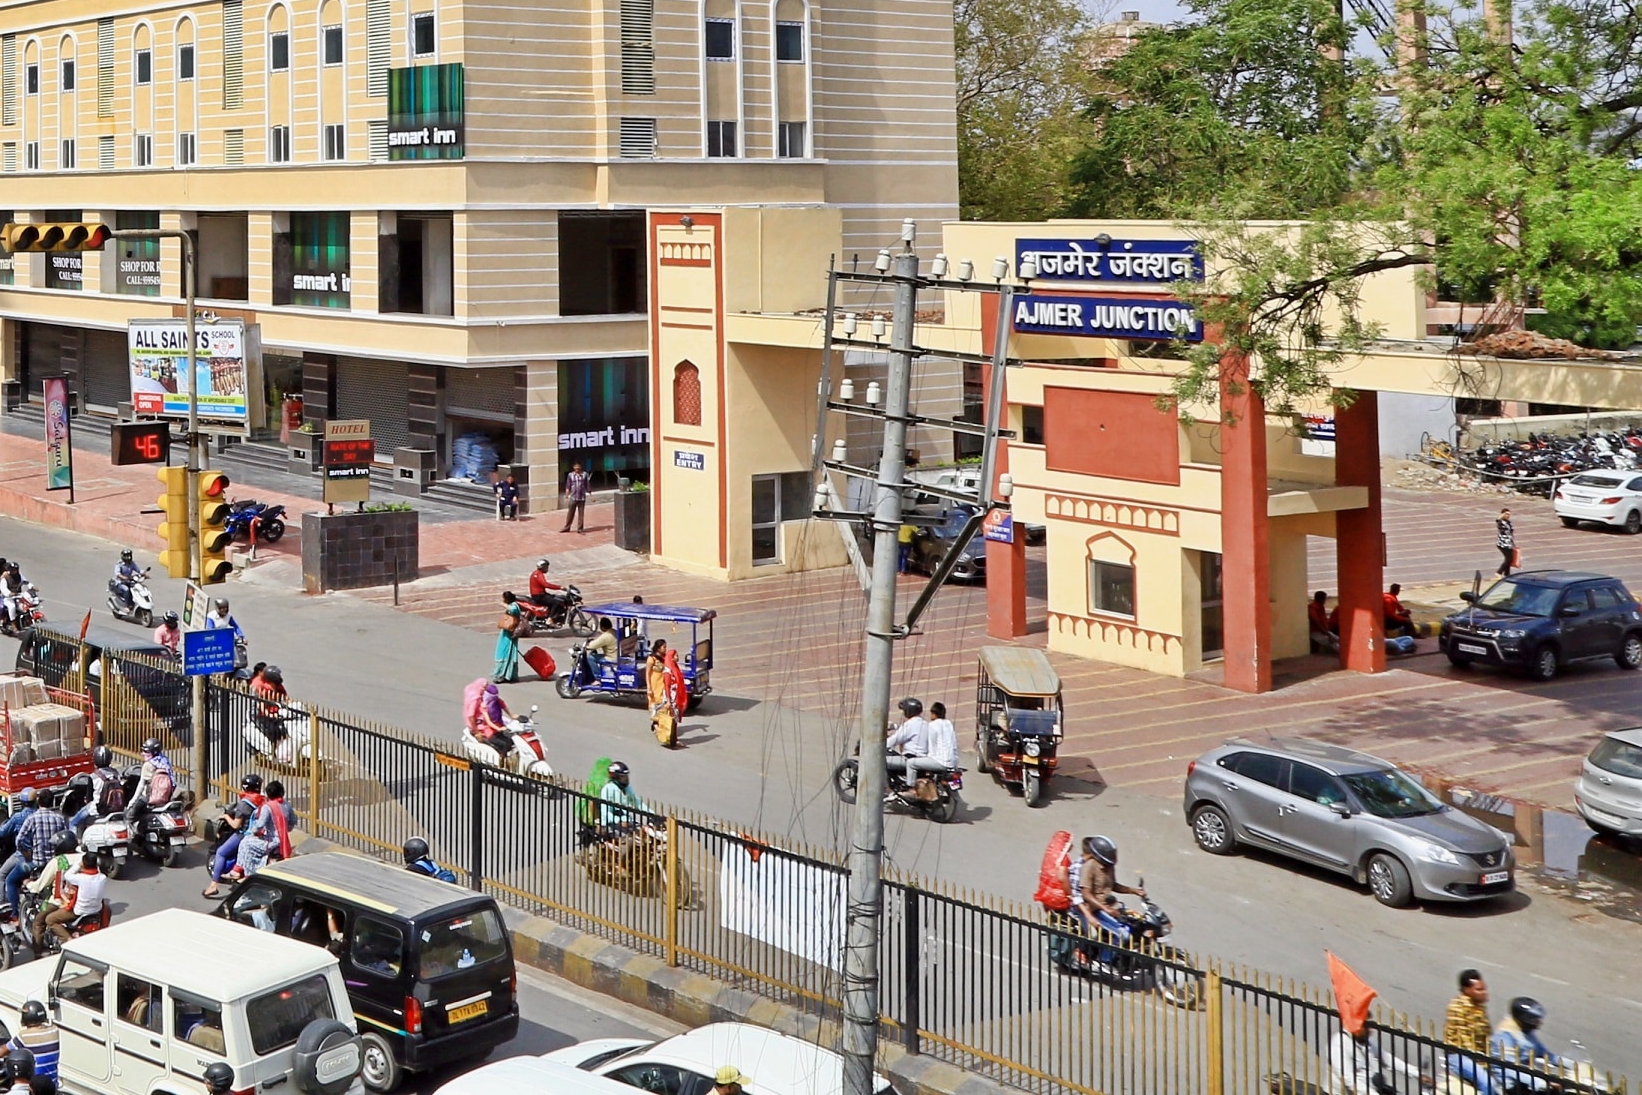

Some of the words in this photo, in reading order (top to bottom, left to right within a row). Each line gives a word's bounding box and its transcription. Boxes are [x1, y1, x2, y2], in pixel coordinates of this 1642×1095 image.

[389, 127, 429, 146] smart
[433, 127, 456, 144] inn
[52, 257, 70, 269] SHOP
[70, 258, 82, 269] FOR
[120, 261, 140, 272] SHOP
[141, 262, 156, 272] FOR
[293, 272, 338, 292] smart
[1015, 302, 1084, 328] AJMER
[1090, 304, 1197, 333] JUNCTION
[136, 330, 157, 348] ALL
[211, 331, 235, 339] SCHOOL
[331, 425, 366, 434] HOTEL
[558, 425, 615, 450] smart
[620, 425, 650, 444] inn
[135, 434, 160, 459] 46
[329, 468, 354, 476] smart
[355, 467, 369, 475] inn
[676, 458, 702, 469] ENTRY
